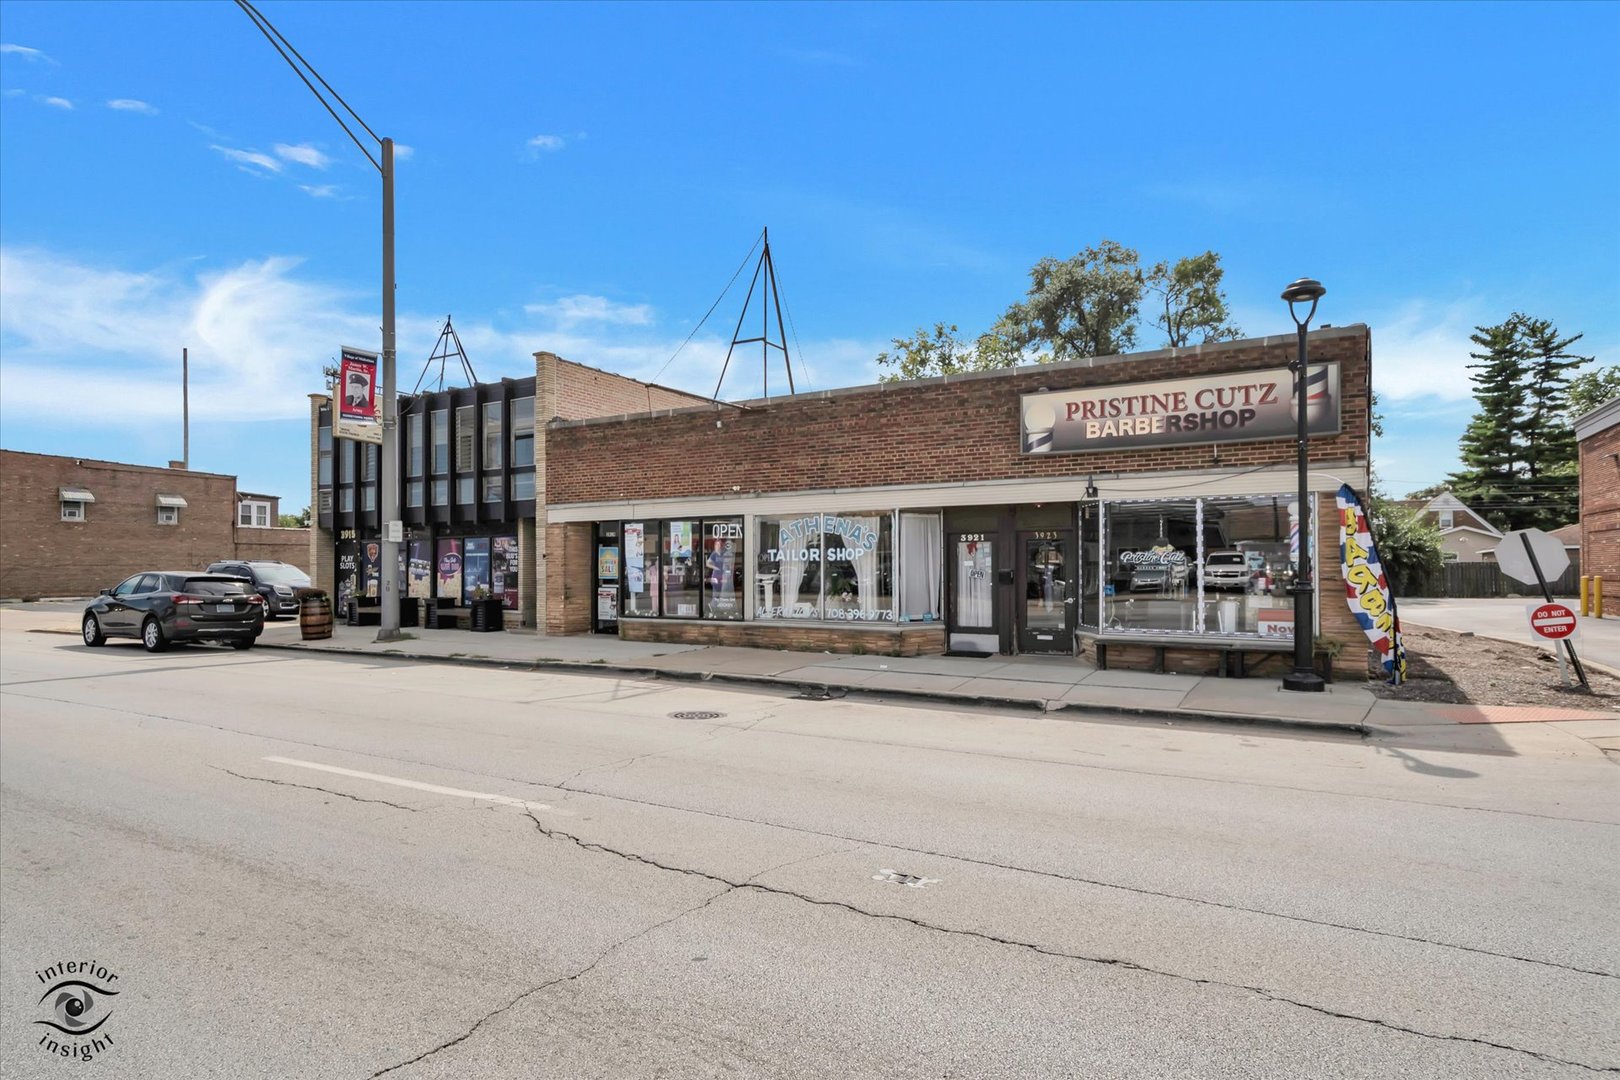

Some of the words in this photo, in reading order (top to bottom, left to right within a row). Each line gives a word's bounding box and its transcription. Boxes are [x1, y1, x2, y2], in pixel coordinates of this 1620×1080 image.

[1065, 391, 1188, 422] PRISTINE
[1195, 382, 1279, 410] CUTZ
[1086, 408, 1256, 439] BARBERSHOP
[340, 529, 356, 539] 3915
[712, 523, 743, 539] OPEN
[779, 516, 878, 552] ATHENA'S
[960, 533, 985, 541] 3921
[341, 555, 354, 563] PLAY
[767, 548, 820, 562] TAILOR
[827, 547, 865, 561] SHOP
[340, 562, 356, 570] SLOTS
[1551, 609, 1566, 617] NOT
[1543, 625, 1568, 633] ENTER
